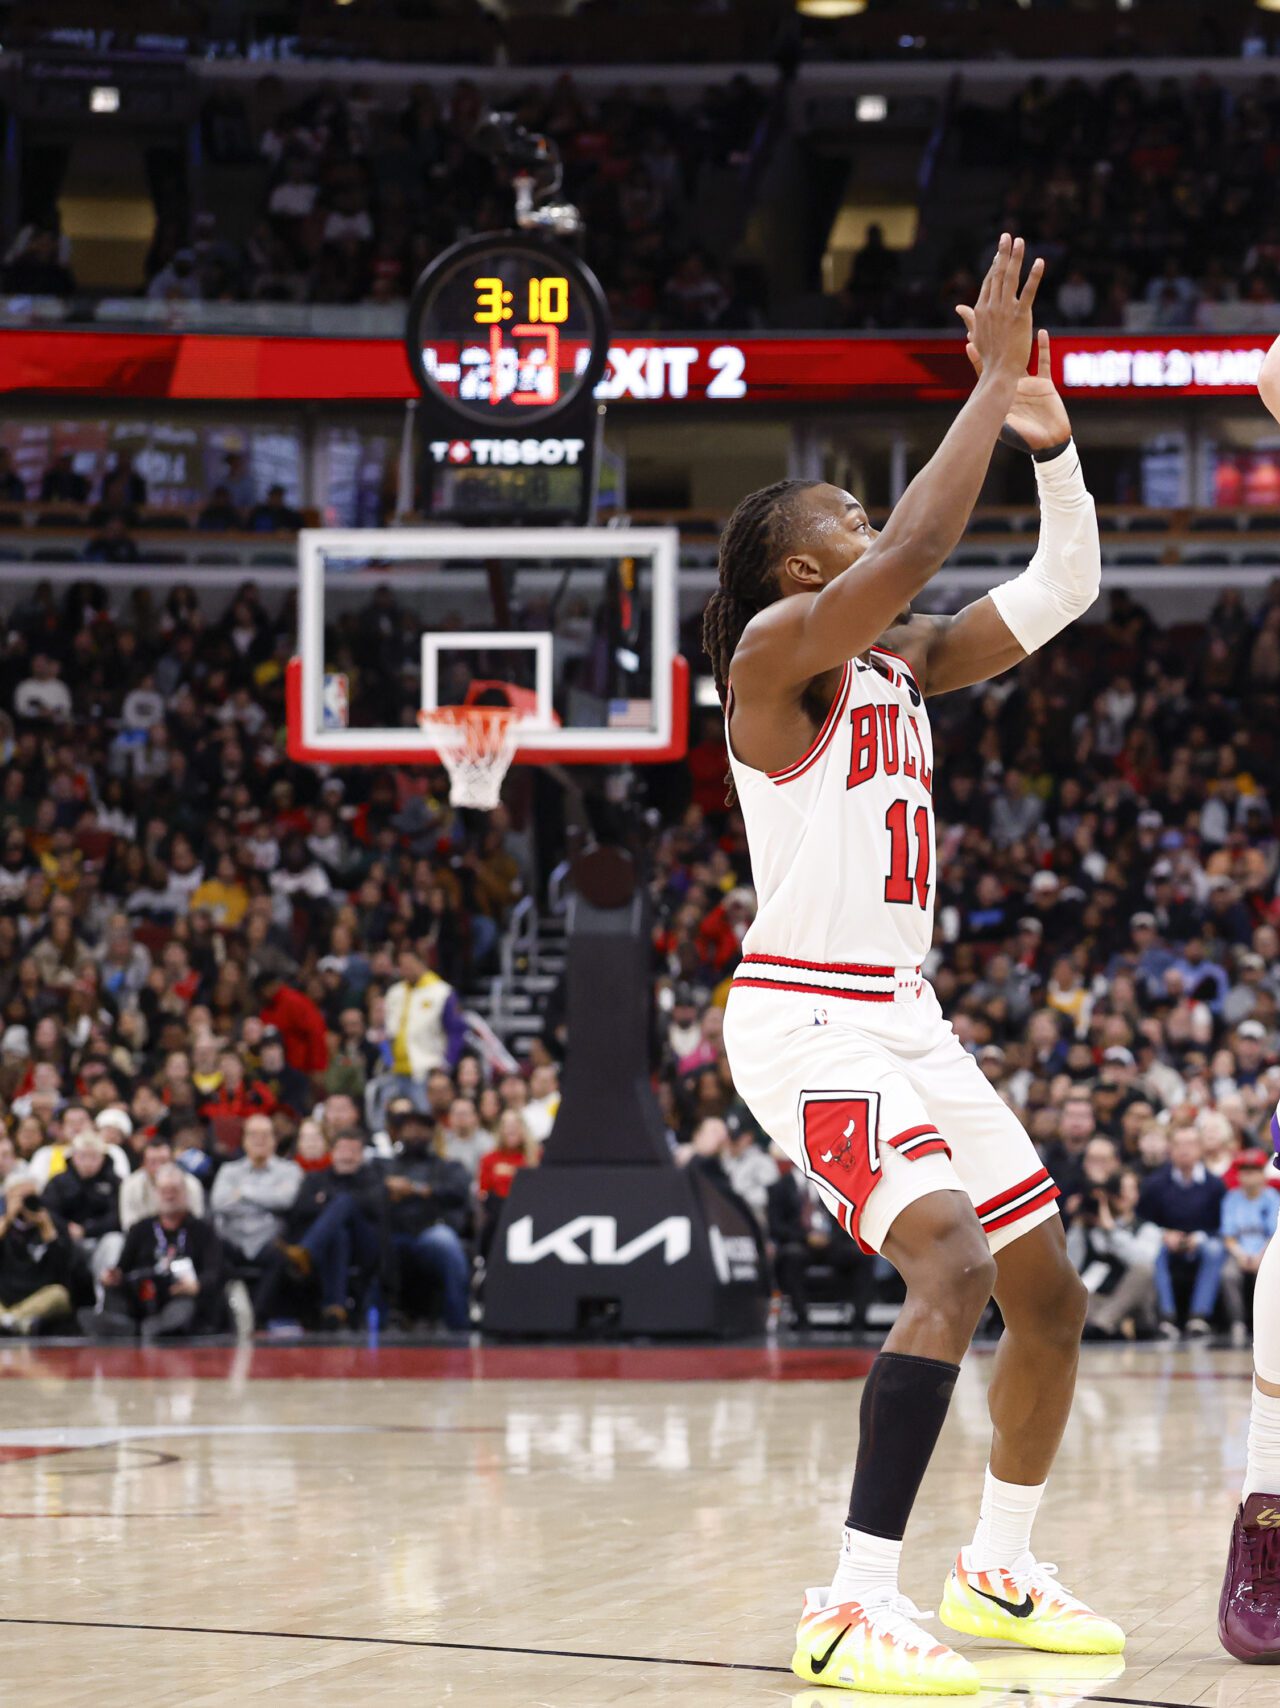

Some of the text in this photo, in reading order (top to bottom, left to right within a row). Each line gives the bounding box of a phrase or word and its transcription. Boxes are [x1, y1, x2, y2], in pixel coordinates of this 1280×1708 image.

[474, 278, 569, 323] 3:10
[707, 346, 747, 399] 2
[471, 439, 584, 465] TISSOT
[846, 702, 932, 795] BULL
[884, 798, 931, 911] 11
